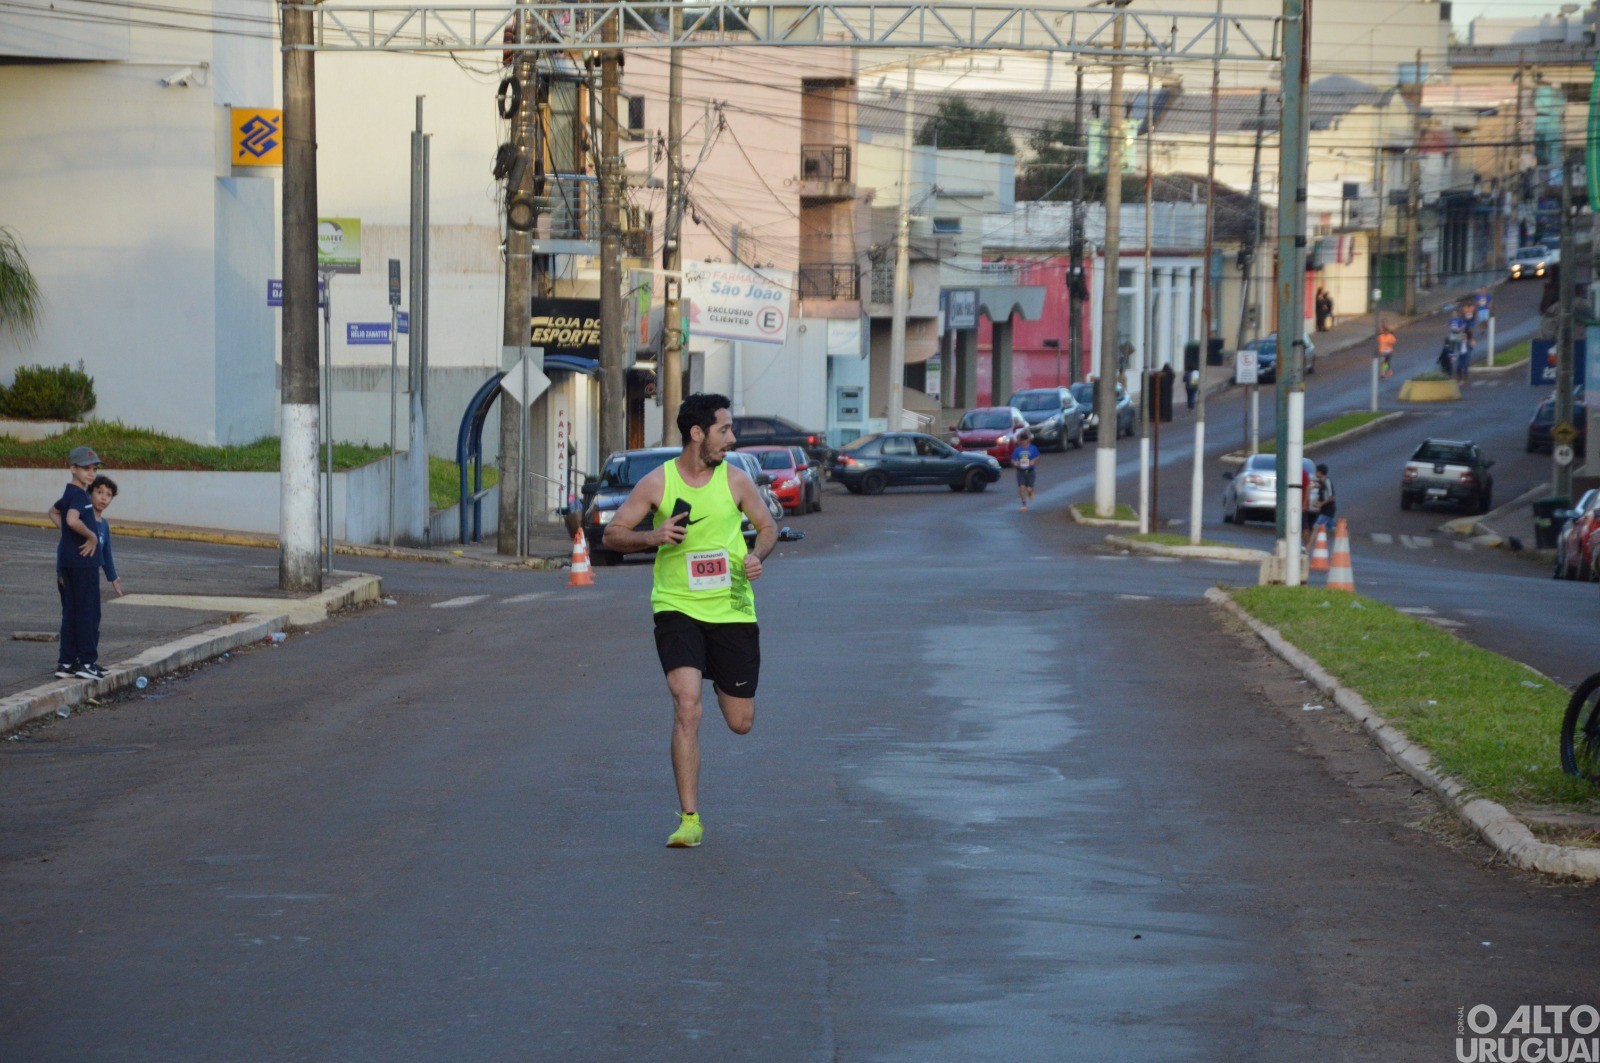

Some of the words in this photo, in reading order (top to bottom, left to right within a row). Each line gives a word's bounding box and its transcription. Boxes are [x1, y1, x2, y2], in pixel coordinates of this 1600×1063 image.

[710, 281, 740, 297] São
[745, 285, 782, 301] João
[707, 306, 753, 317] EXCLUSIVO
[547, 316, 581, 328] LOJA
[709, 314, 749, 325] CLIENTES
[763, 311, 776, 328] E
[696, 561, 722, 574] 031
